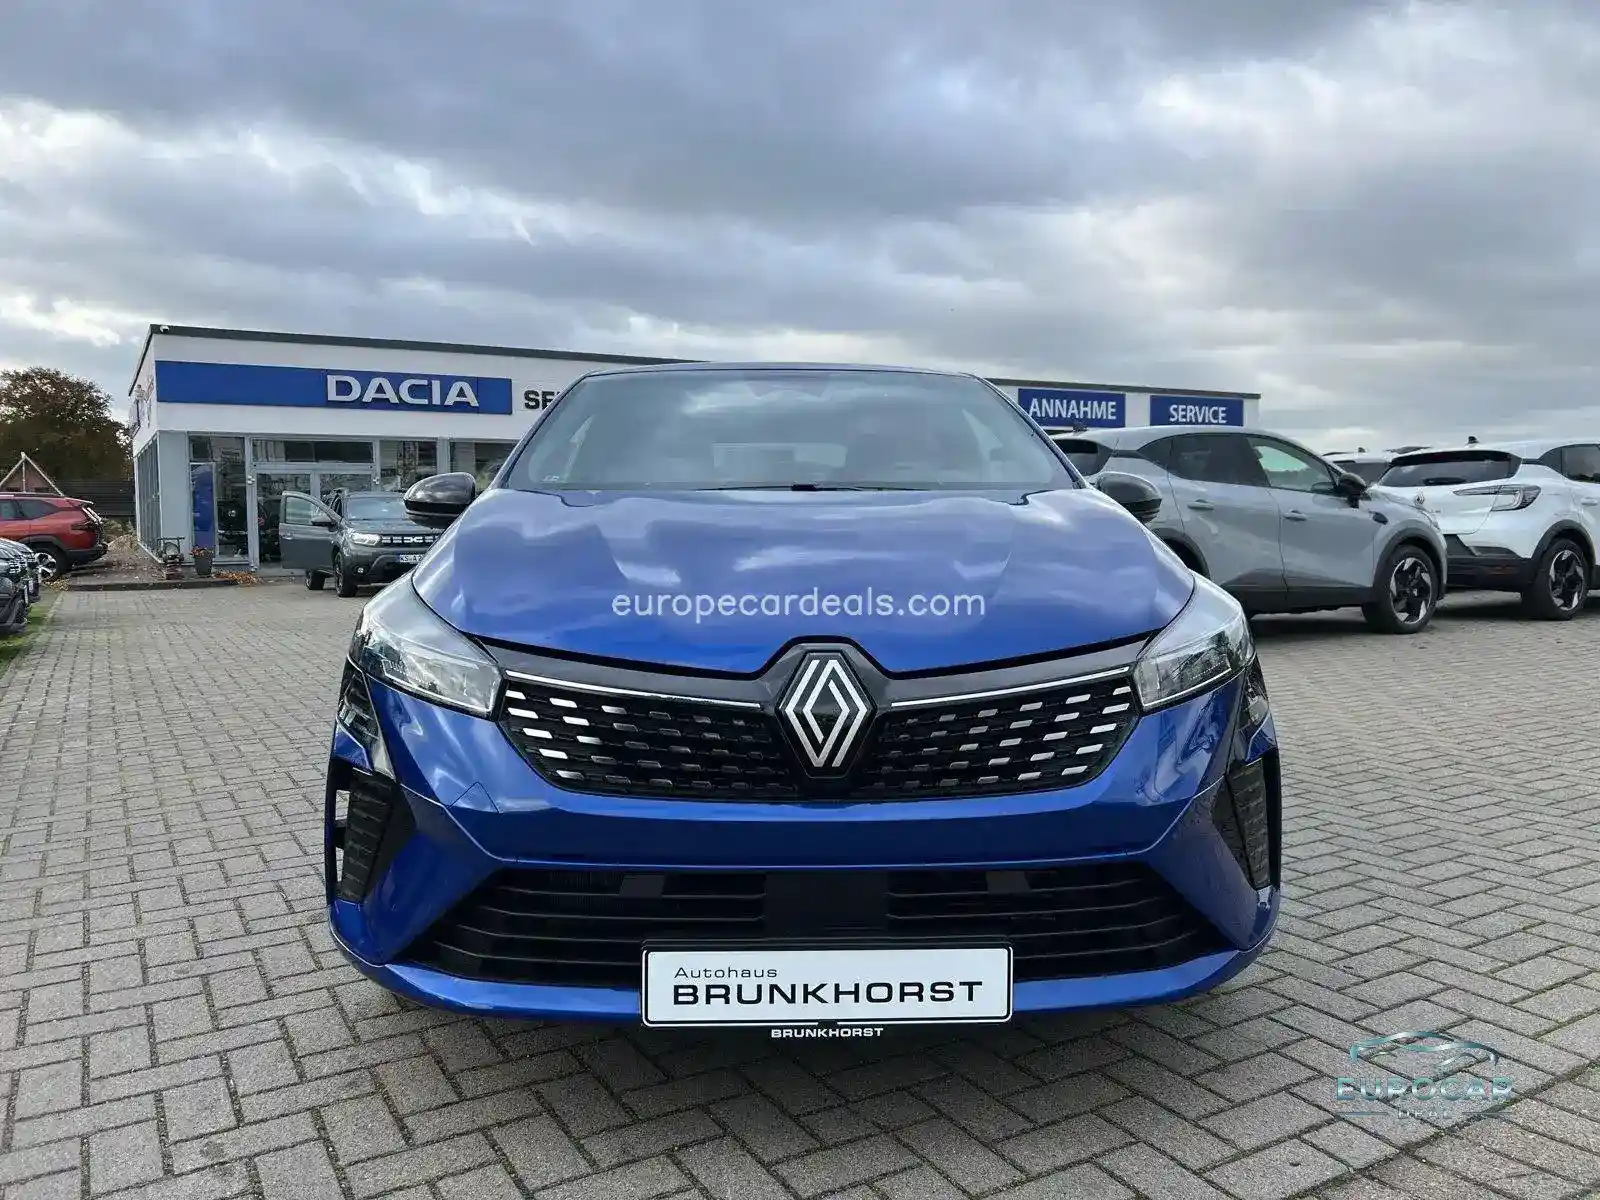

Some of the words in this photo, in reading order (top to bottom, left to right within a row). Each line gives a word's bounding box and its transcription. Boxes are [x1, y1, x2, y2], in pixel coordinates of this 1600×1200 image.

[327, 374, 479, 407] DACIA
[524, 390, 561, 410] SE
[1028, 397, 1117, 420] ANNAHME
[1169, 404, 1227, 424] SERVICE
[674, 966, 778, 979] Autohaus
[673, 981, 983, 1006] BRUNKHORST
[770, 1027, 884, 1039] BRUNKHORST
